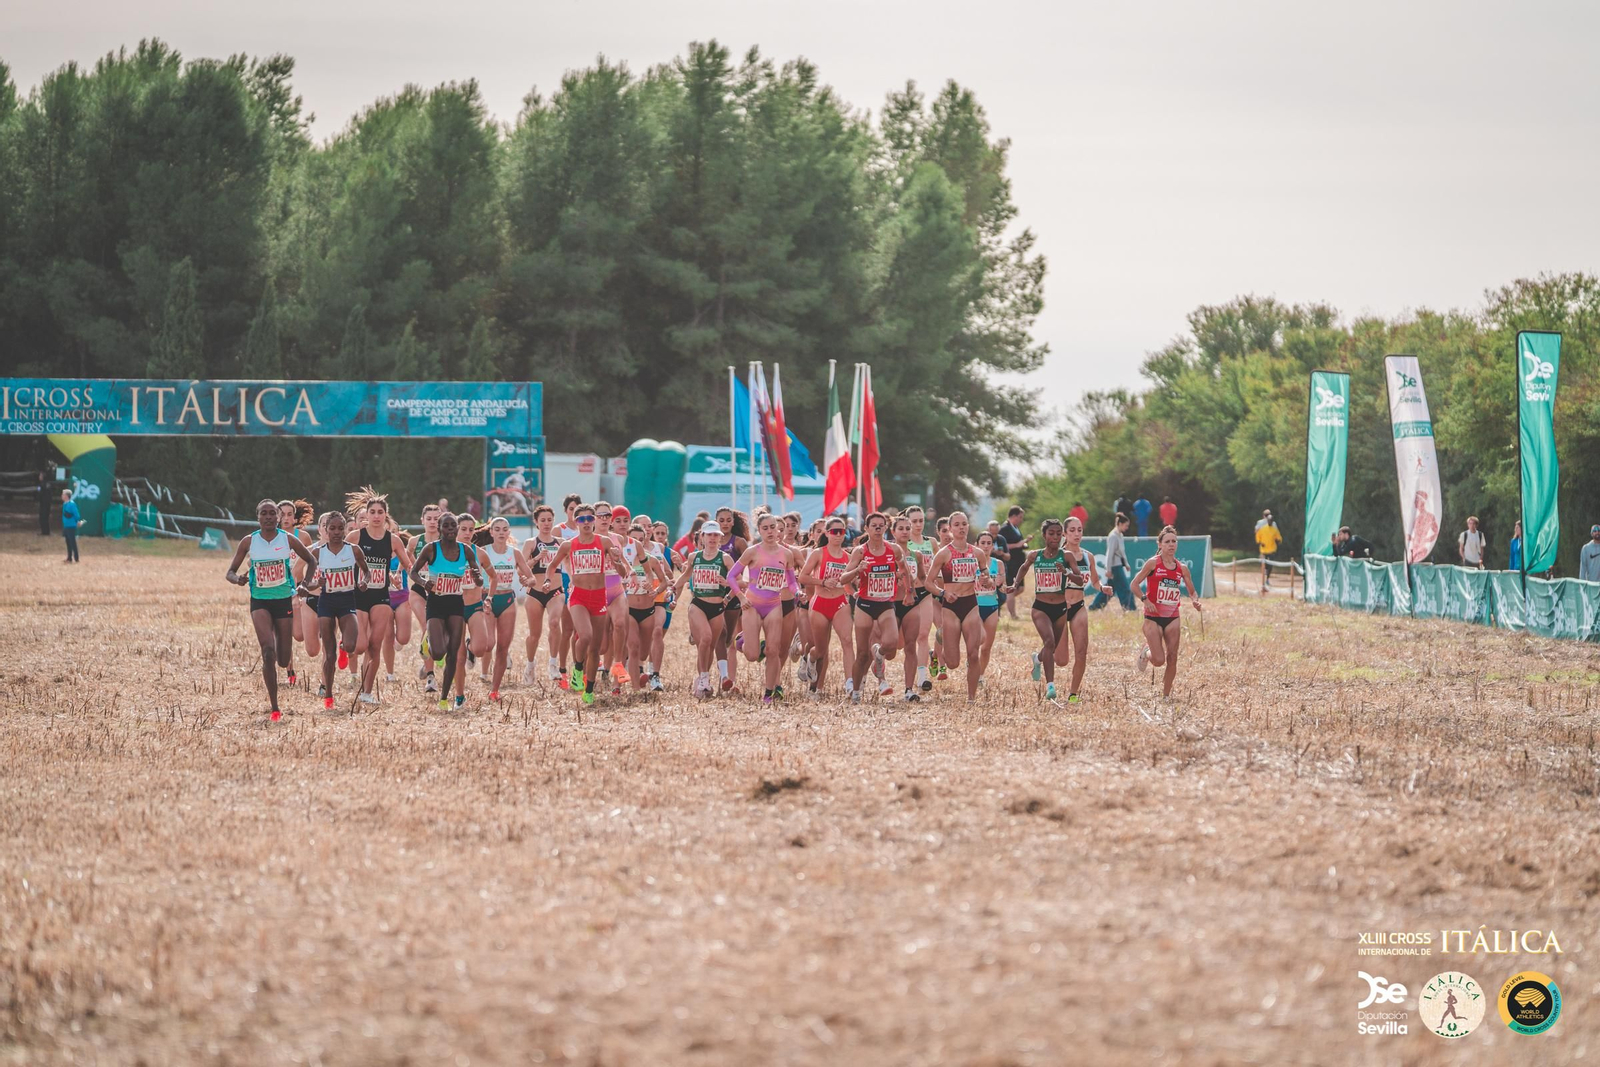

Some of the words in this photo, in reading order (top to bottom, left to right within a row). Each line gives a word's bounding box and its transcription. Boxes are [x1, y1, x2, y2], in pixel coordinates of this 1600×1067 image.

[14, 387, 94, 408] CROSS
[130, 380, 321, 426] ITÁLICA
[387, 399, 455, 409] CAMPEONATO
[456, 399, 469, 409] DE
[470, 398, 528, 409] ANDALUCÍA
[14, 409, 122, 420] INTERNACIONAL
[409, 408, 422, 417] DE
[423, 408, 459, 417] CAMPO
[460, 408, 469, 417] A
[8, 422, 44, 432] CROSS
[46, 422, 103, 433] COUNTRY
[431, 417, 450, 426] POR
[452, 417, 487, 426] CLUBES
[1315, 417, 1345, 427] Sevilla
[574, 553, 601, 569] MACHADO
[326, 570, 354, 588] YAVI
[693, 569, 718, 586] CORRAL
[758, 571, 784, 588] FORERO
[869, 577, 894, 592] ROBLES
[1158, 587, 1180, 601] DÍAZ
